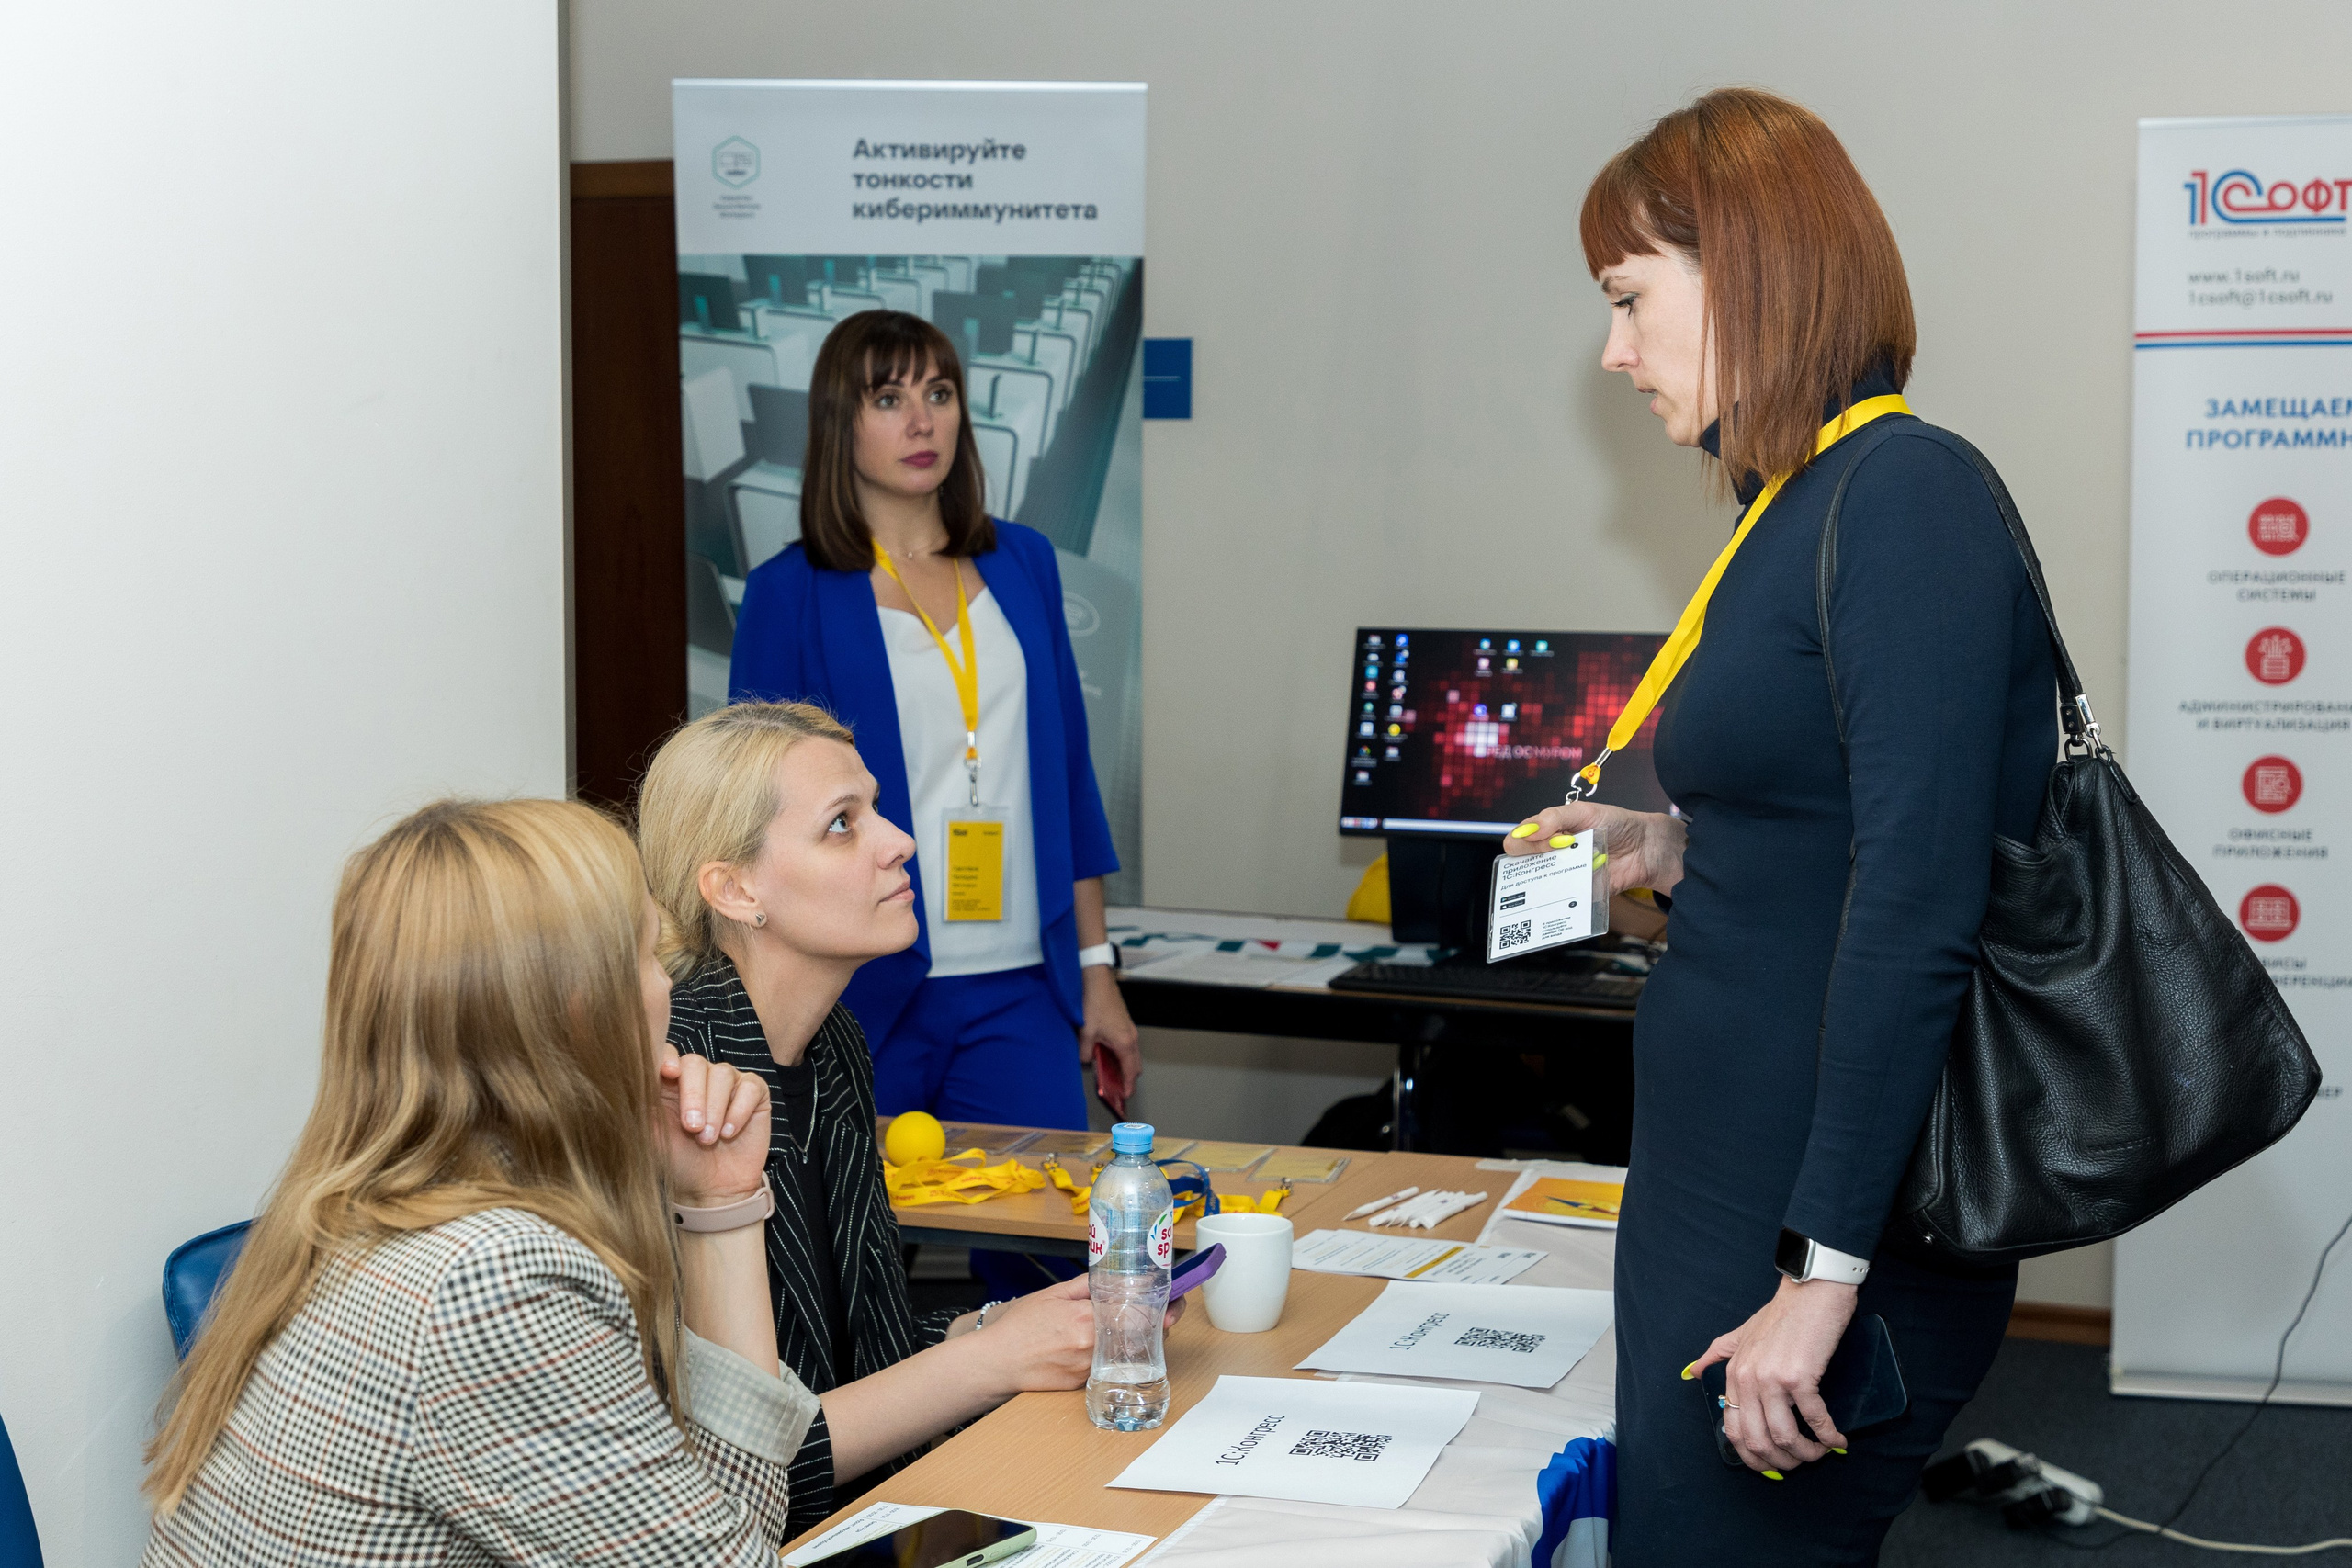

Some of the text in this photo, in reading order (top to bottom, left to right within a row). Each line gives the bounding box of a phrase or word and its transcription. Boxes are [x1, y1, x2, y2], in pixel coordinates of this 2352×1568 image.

[854, 138, 1027, 164] Активируйте
[854, 172, 973, 190] тонкости
[853, 198, 1098, 222] кибериммунитета
[2236, 589, 2316, 601] СИСТЕМЫ
[2178, 700, 2352, 714] АДМИНИСТРИРОВАН
[1502, 855, 1557, 875] приложение
[1503, 854, 1544, 869] Скачайте
[1501, 883, 1514, 891] Для
[1515, 875, 1543, 887] доступа
[1549, 863, 1587, 877] программе
[1389, 1312, 1451, 1350] 1С:Конгресс
[1215, 1414, 1285, 1466] 1С:Конгресс
